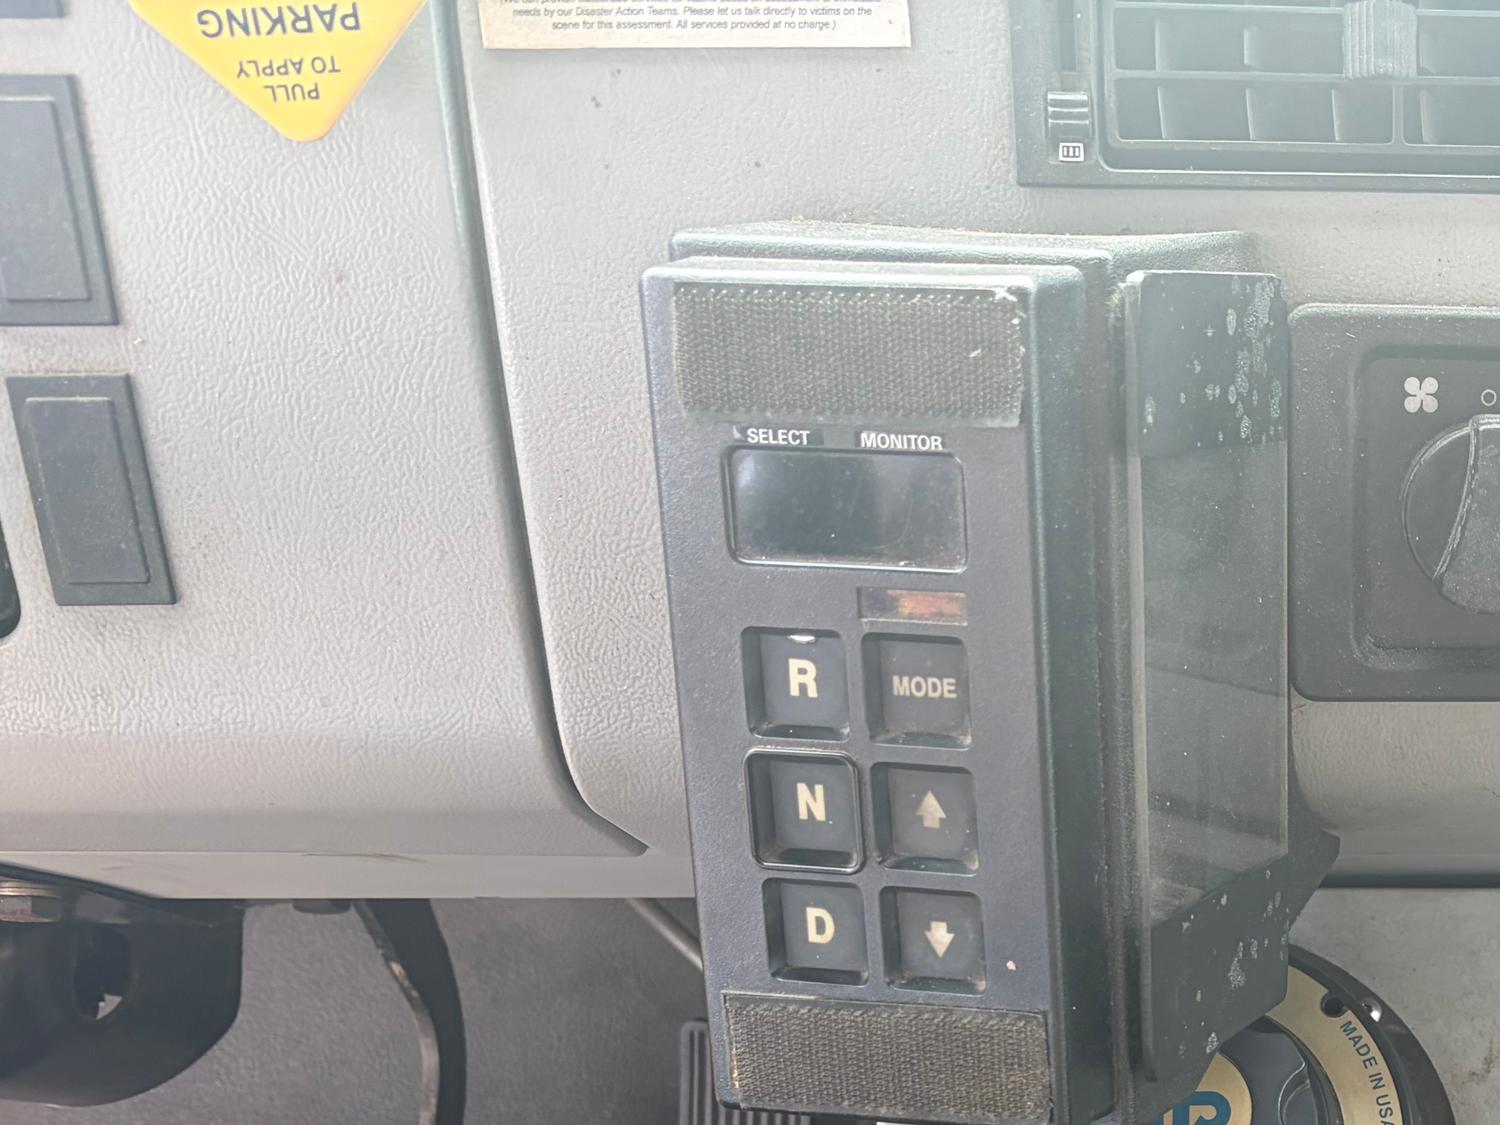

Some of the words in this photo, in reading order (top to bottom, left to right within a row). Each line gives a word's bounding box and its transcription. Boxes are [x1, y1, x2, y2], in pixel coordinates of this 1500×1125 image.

[197, 3, 361, 38] PARKING
[513, 8, 541, 17] needs
[575, 6, 613, 17] Disaster
[615, 6, 644, 16] Action
[683, 6, 714, 16] Please
[744, 6, 760, 16] talk
[763, 6, 795, 18] directly
[810, 6, 840, 16] victims
[552, 21, 579, 30] scene
[597, 20, 613, 30] this
[676, 20, 688, 30] All
[691, 20, 727, 30] services
[731, 19, 769, 31] provided
[236, 58, 304, 79] APPLY
[311, 55, 341, 73] TO
[263, 83, 321, 103] PULL
[747, 428, 811, 446] SELECT
[860, 431, 943, 451] MONITOR
[788, 658, 818, 698] R
[892, 675, 957, 699] MODE
[796, 782, 827, 822] N
[806, 906, 835, 944] D
[1340, 1021, 1378, 1069] MADE
[1368, 1072, 1385, 1090] IN
